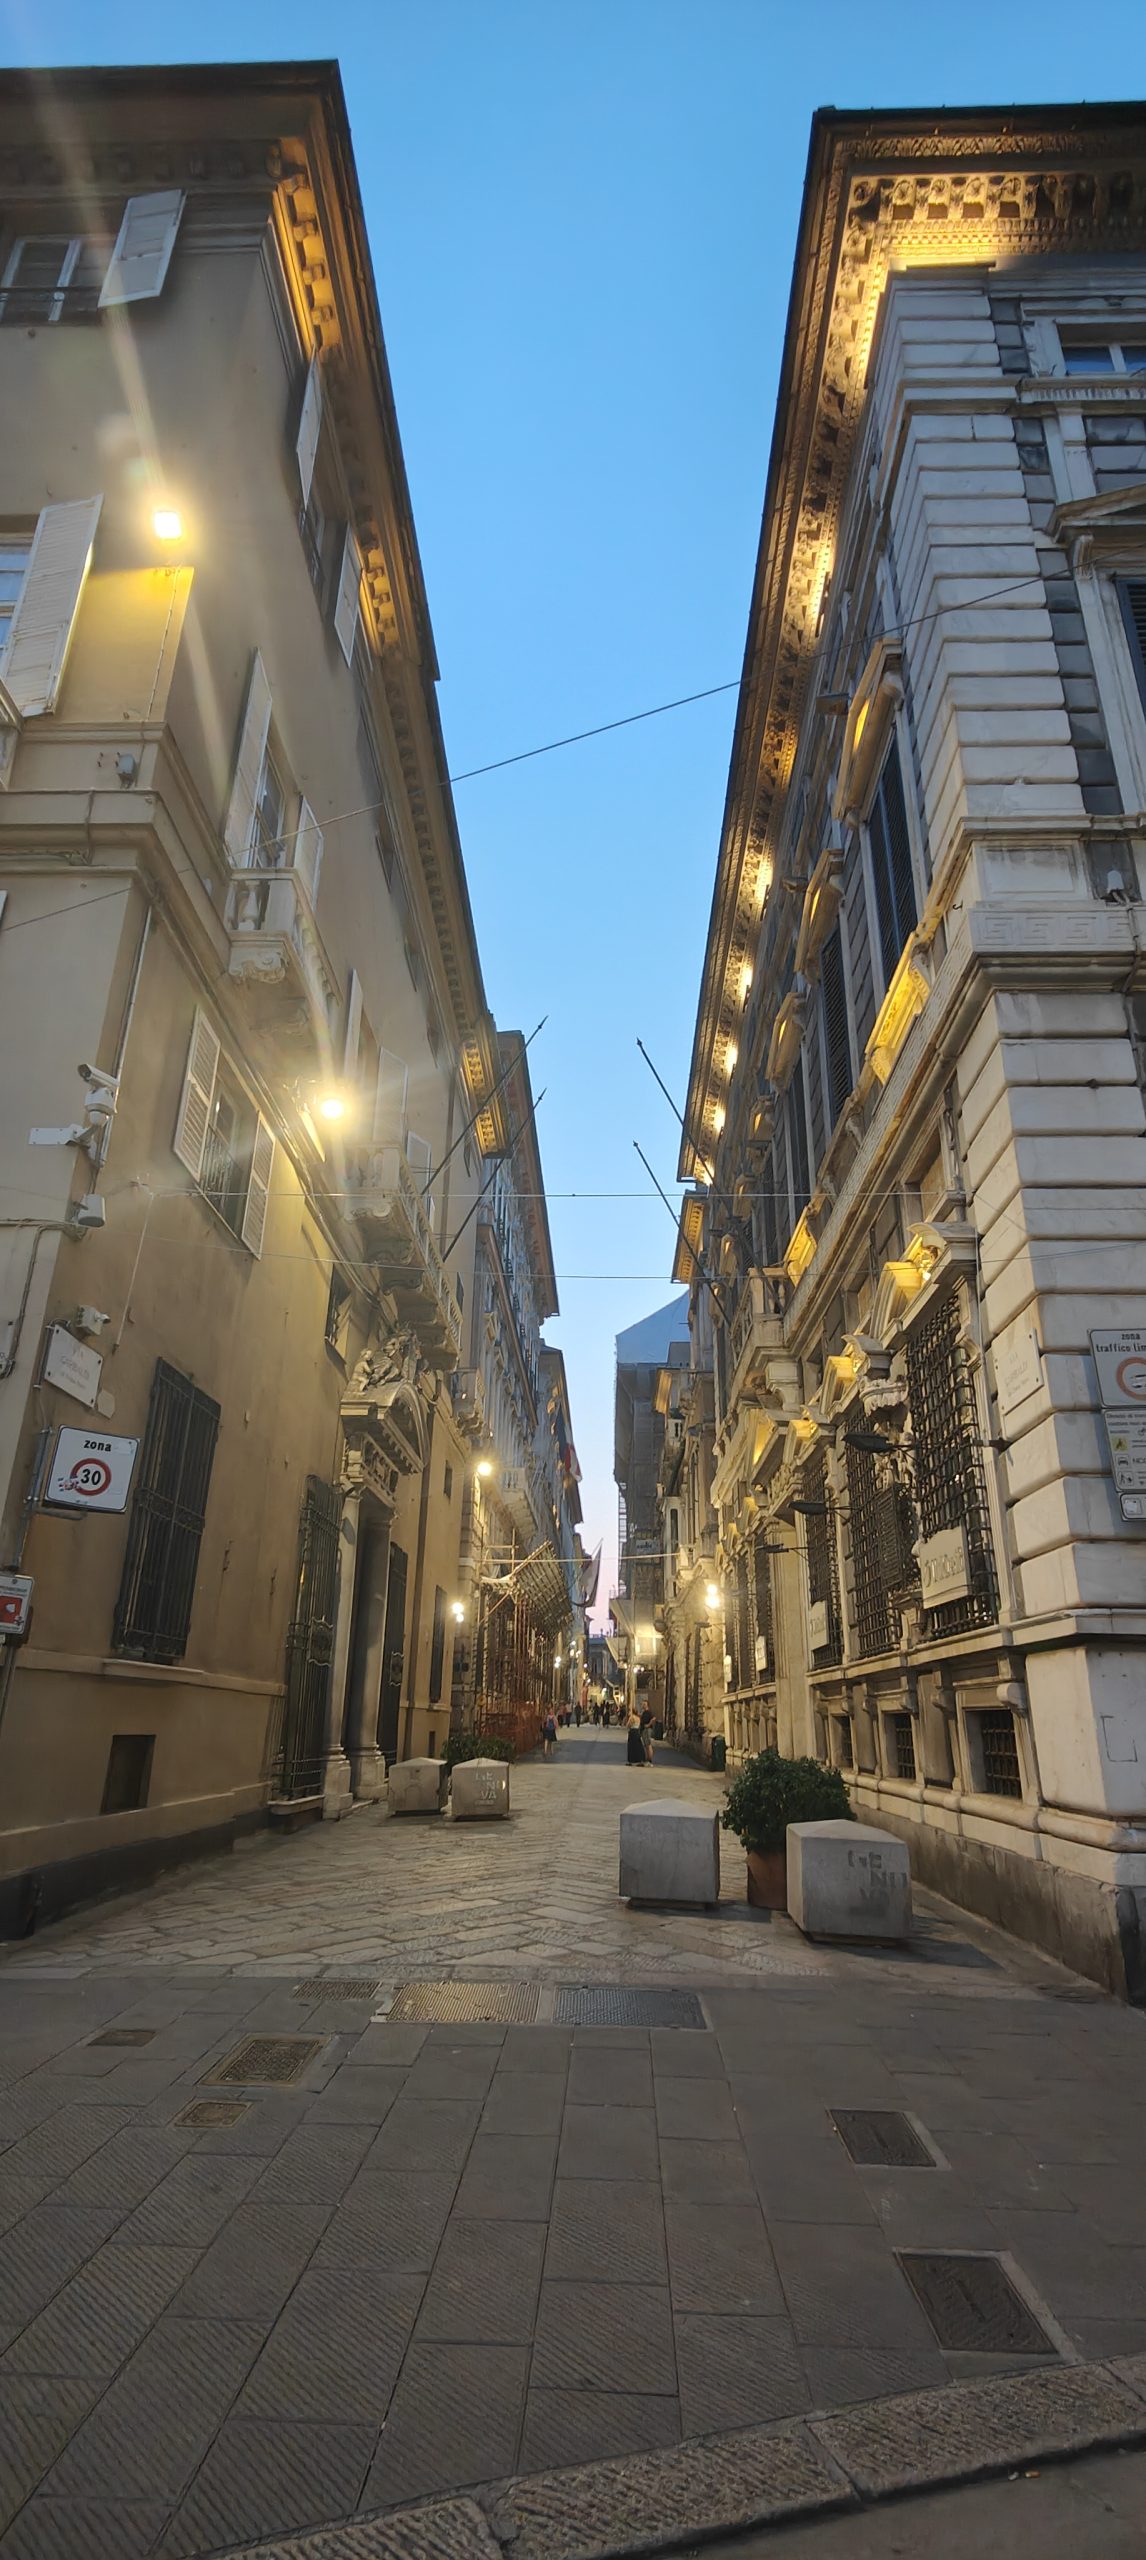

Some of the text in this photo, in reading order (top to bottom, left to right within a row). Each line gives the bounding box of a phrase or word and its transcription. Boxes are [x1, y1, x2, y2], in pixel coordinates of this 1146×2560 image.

[1096, 1343, 1131, 1352] traffico
[83, 1440, 112, 1452] zona
[80, 1468, 101, 1485] 30
[480, 1790, 497, 1799] VA
